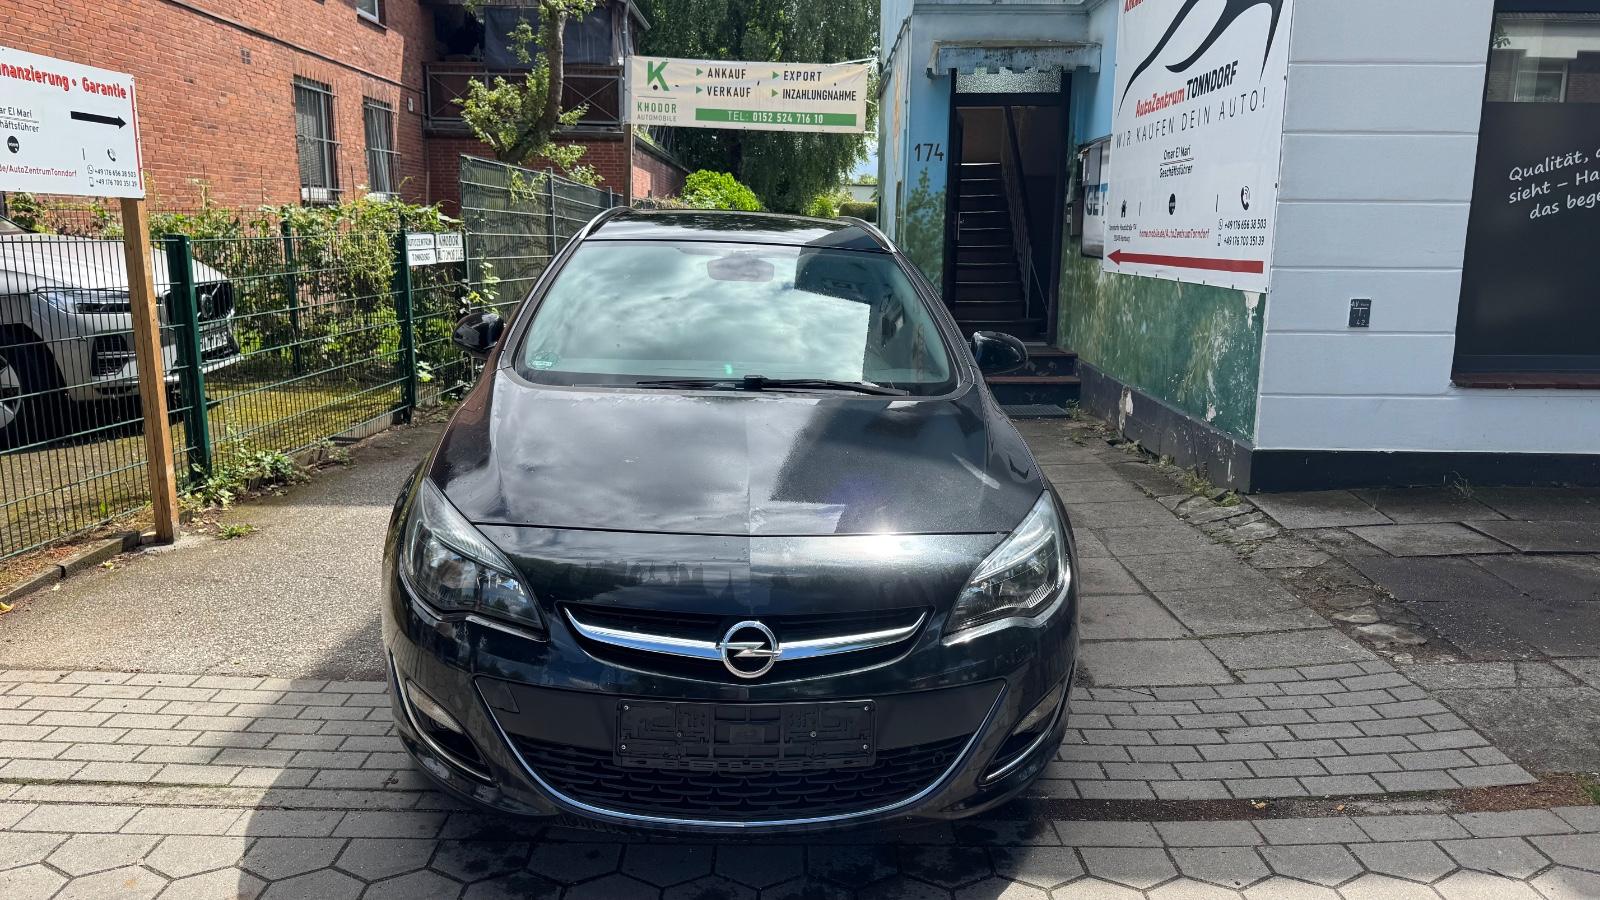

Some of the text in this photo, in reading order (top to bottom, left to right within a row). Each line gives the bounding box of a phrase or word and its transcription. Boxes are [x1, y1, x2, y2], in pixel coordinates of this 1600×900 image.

[707, 67, 747, 80] ANKAUF
[783, 70, 822, 82] EXPORT
[0, 62, 127, 99] nanzierung Garantie
[706, 85, 751, 98] VERKAUF
[782, 88, 857, 101] INZAHLUNGNAHME
[1136, 60, 1239, 118] AutoZentrum TONNDORF
[8, 106, 16, 116] El
[637, 101, 677, 114] KHODOR
[637, 114, 677, 122] AUTOMOBILE
[728, 111, 824, 124] TEL: 0152 524 716 10
[1116, 86, 1267, 149] WIR KAUFEN DEIN AUTO!
[914, 143, 944, 162] 174
[1508, 150, 1589, 181] Qualität,
[1509, 181, 1550, 204] sieht
[1530, 202, 1560, 219] das
